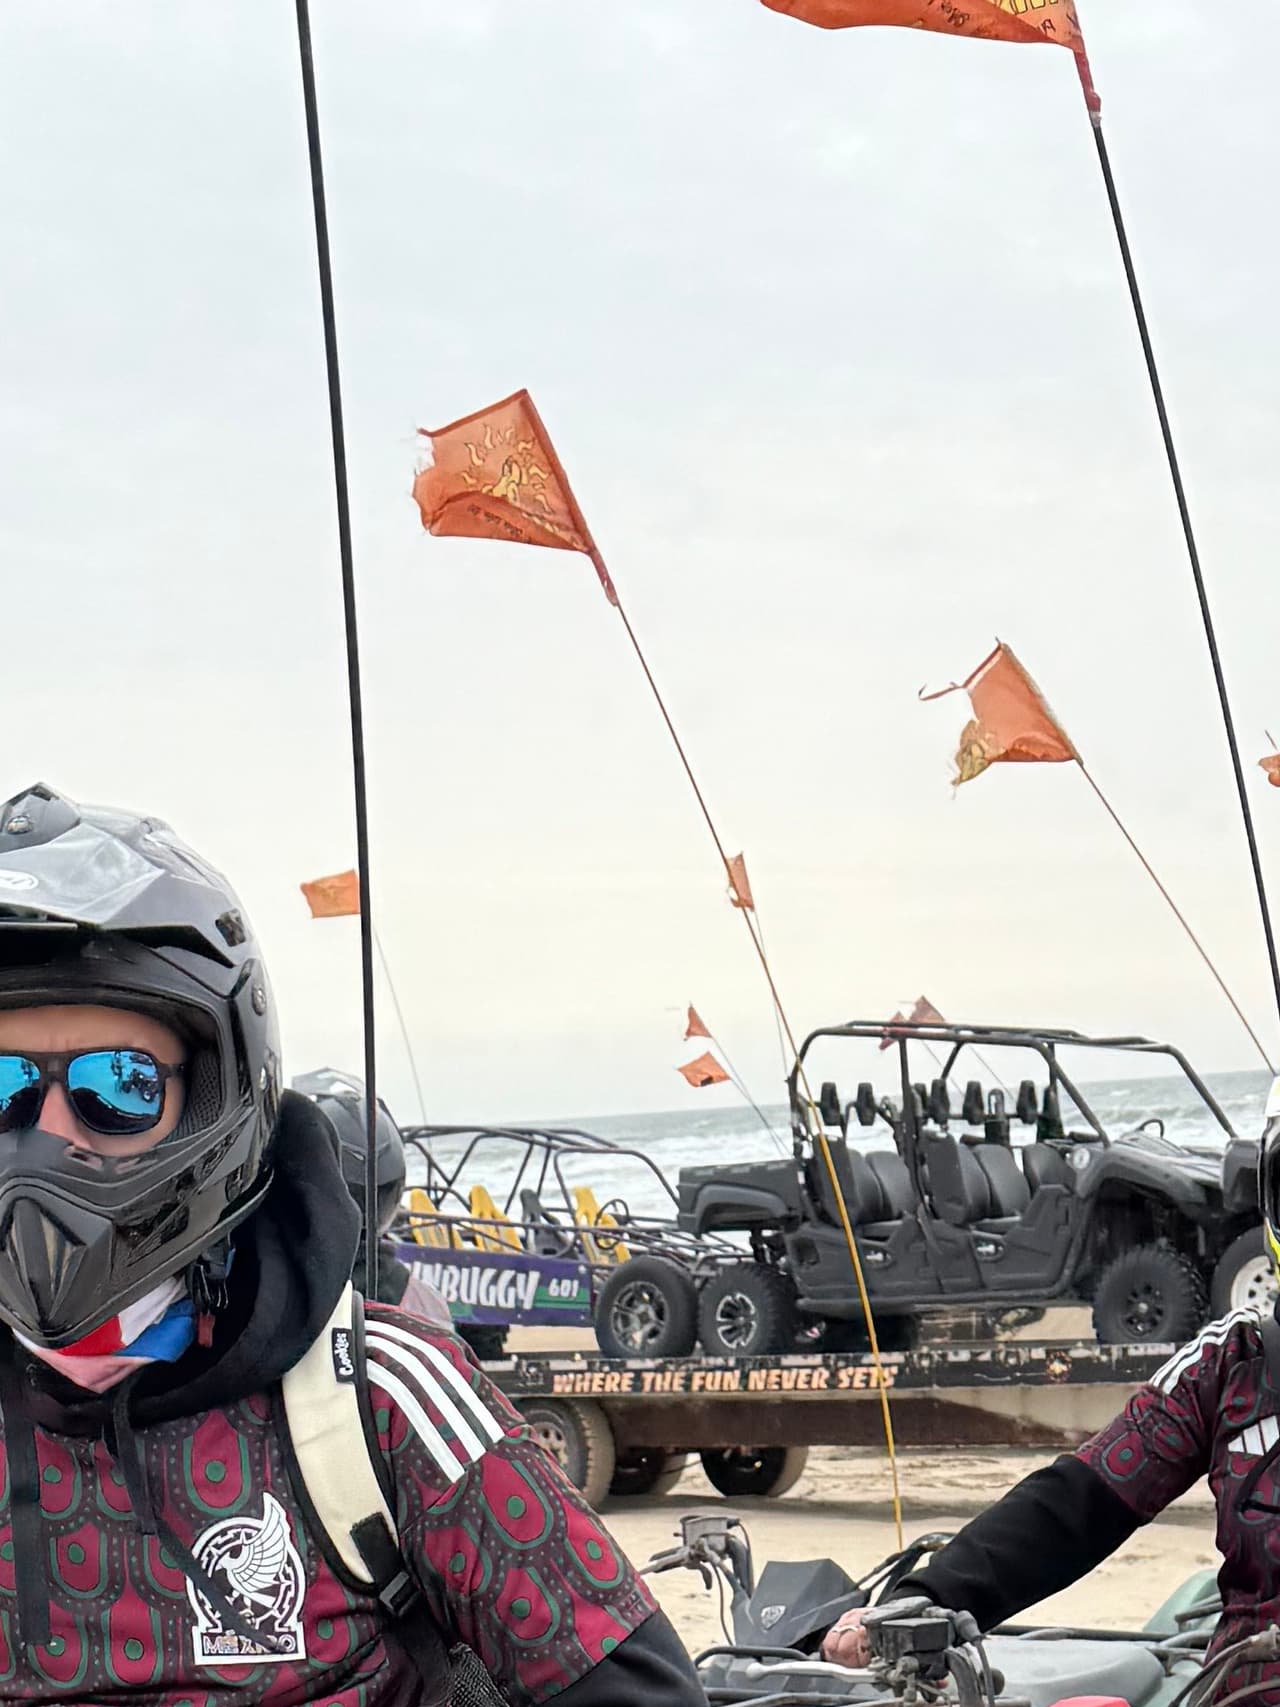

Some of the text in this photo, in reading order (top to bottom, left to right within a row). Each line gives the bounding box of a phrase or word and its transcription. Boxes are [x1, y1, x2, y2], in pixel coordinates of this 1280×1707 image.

[548, 1277, 580, 1298] 601
[552, 1371, 635, 1394] WHERE
[641, 1370, 684, 1393] THE
[691, 1369, 739, 1393] FUN
[747, 1368, 830, 1392] NEVER
[838, 1366, 899, 1389] SETS
